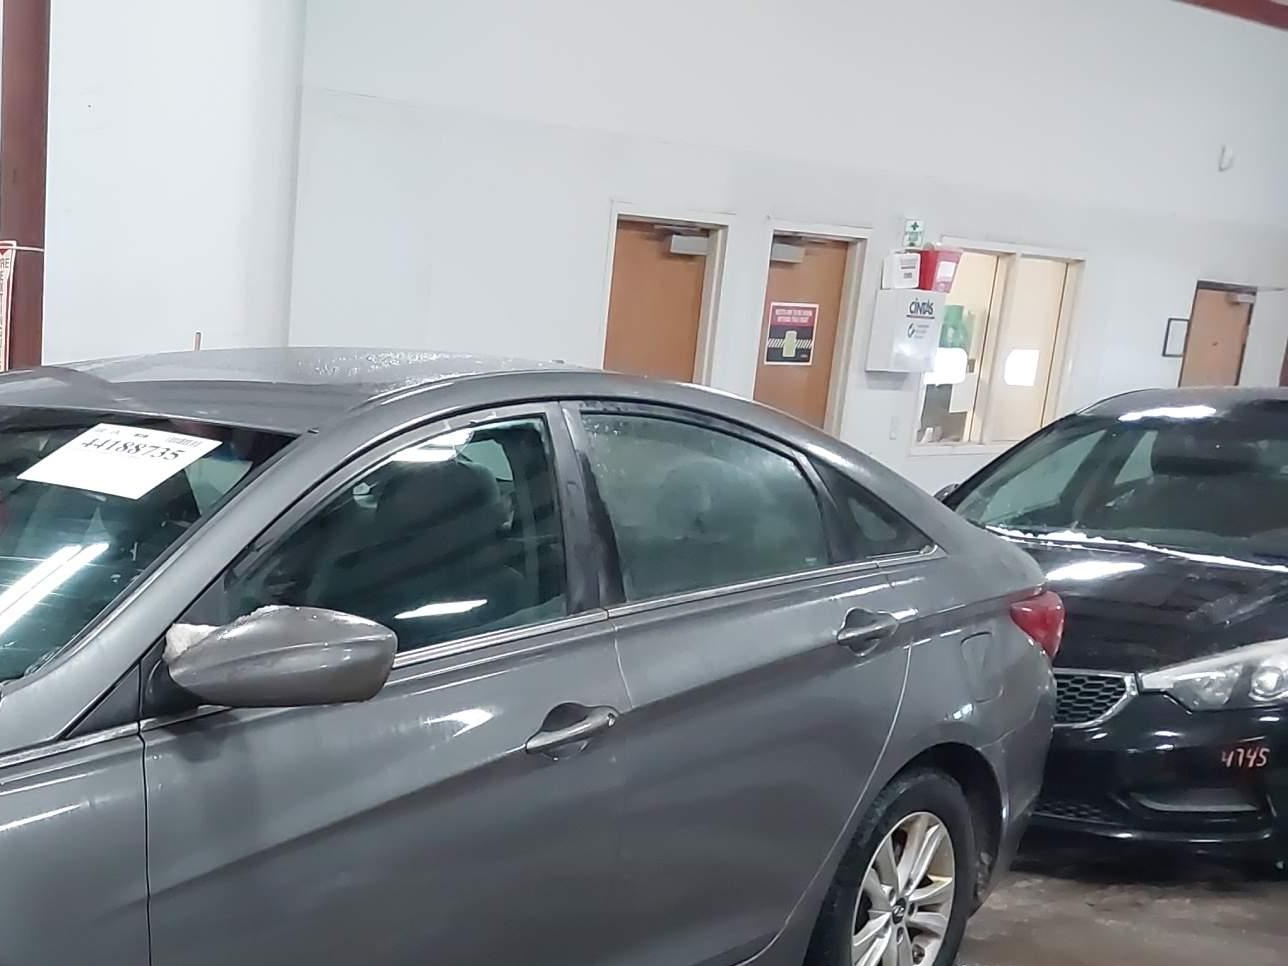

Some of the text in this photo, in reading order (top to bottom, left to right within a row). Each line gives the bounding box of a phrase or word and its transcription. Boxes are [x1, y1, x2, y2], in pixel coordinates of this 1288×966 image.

[909, 297, 934, 315] CINTAS
[82, 437, 185, 461] 44188735
[1221, 746, 1270, 768] 4745
